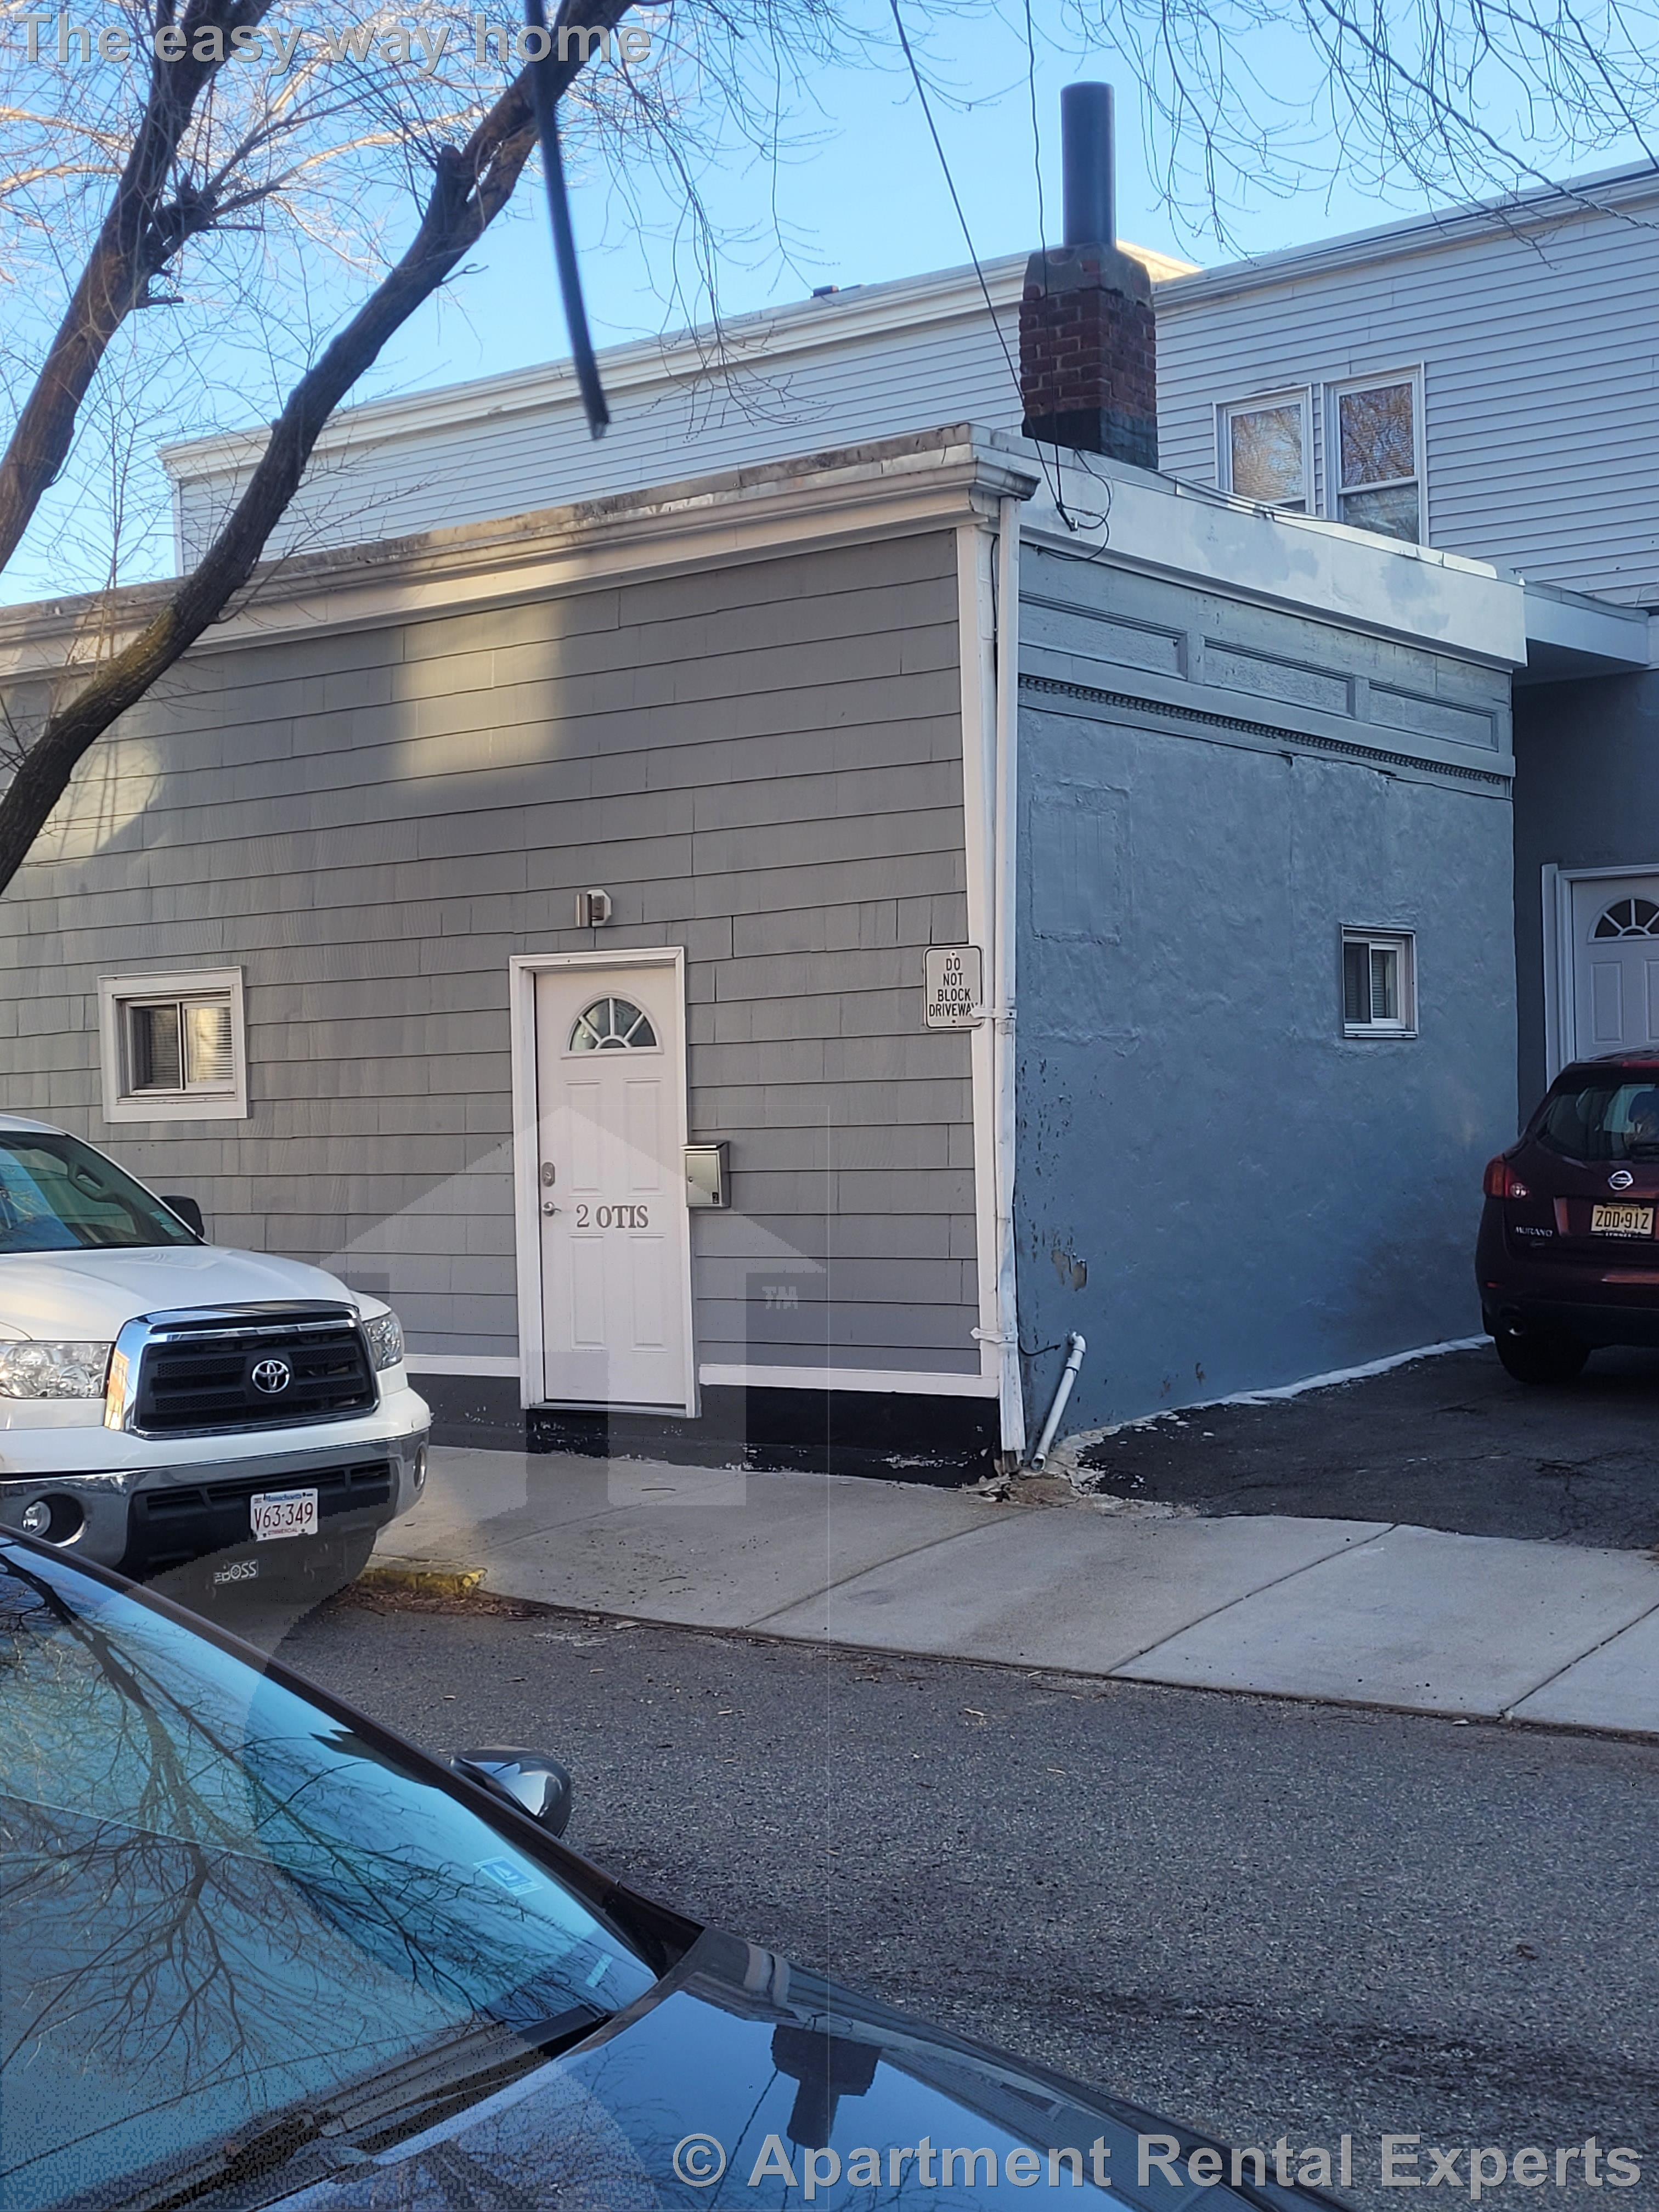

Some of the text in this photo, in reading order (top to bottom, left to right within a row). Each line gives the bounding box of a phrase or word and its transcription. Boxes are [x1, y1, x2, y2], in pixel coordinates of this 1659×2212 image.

[946, 957, 961, 971] DO
[943, 972, 963, 986] NOT
[937, 988, 971, 1002] BLOCK
[577, 1204, 649, 1228] 2 OTIS
